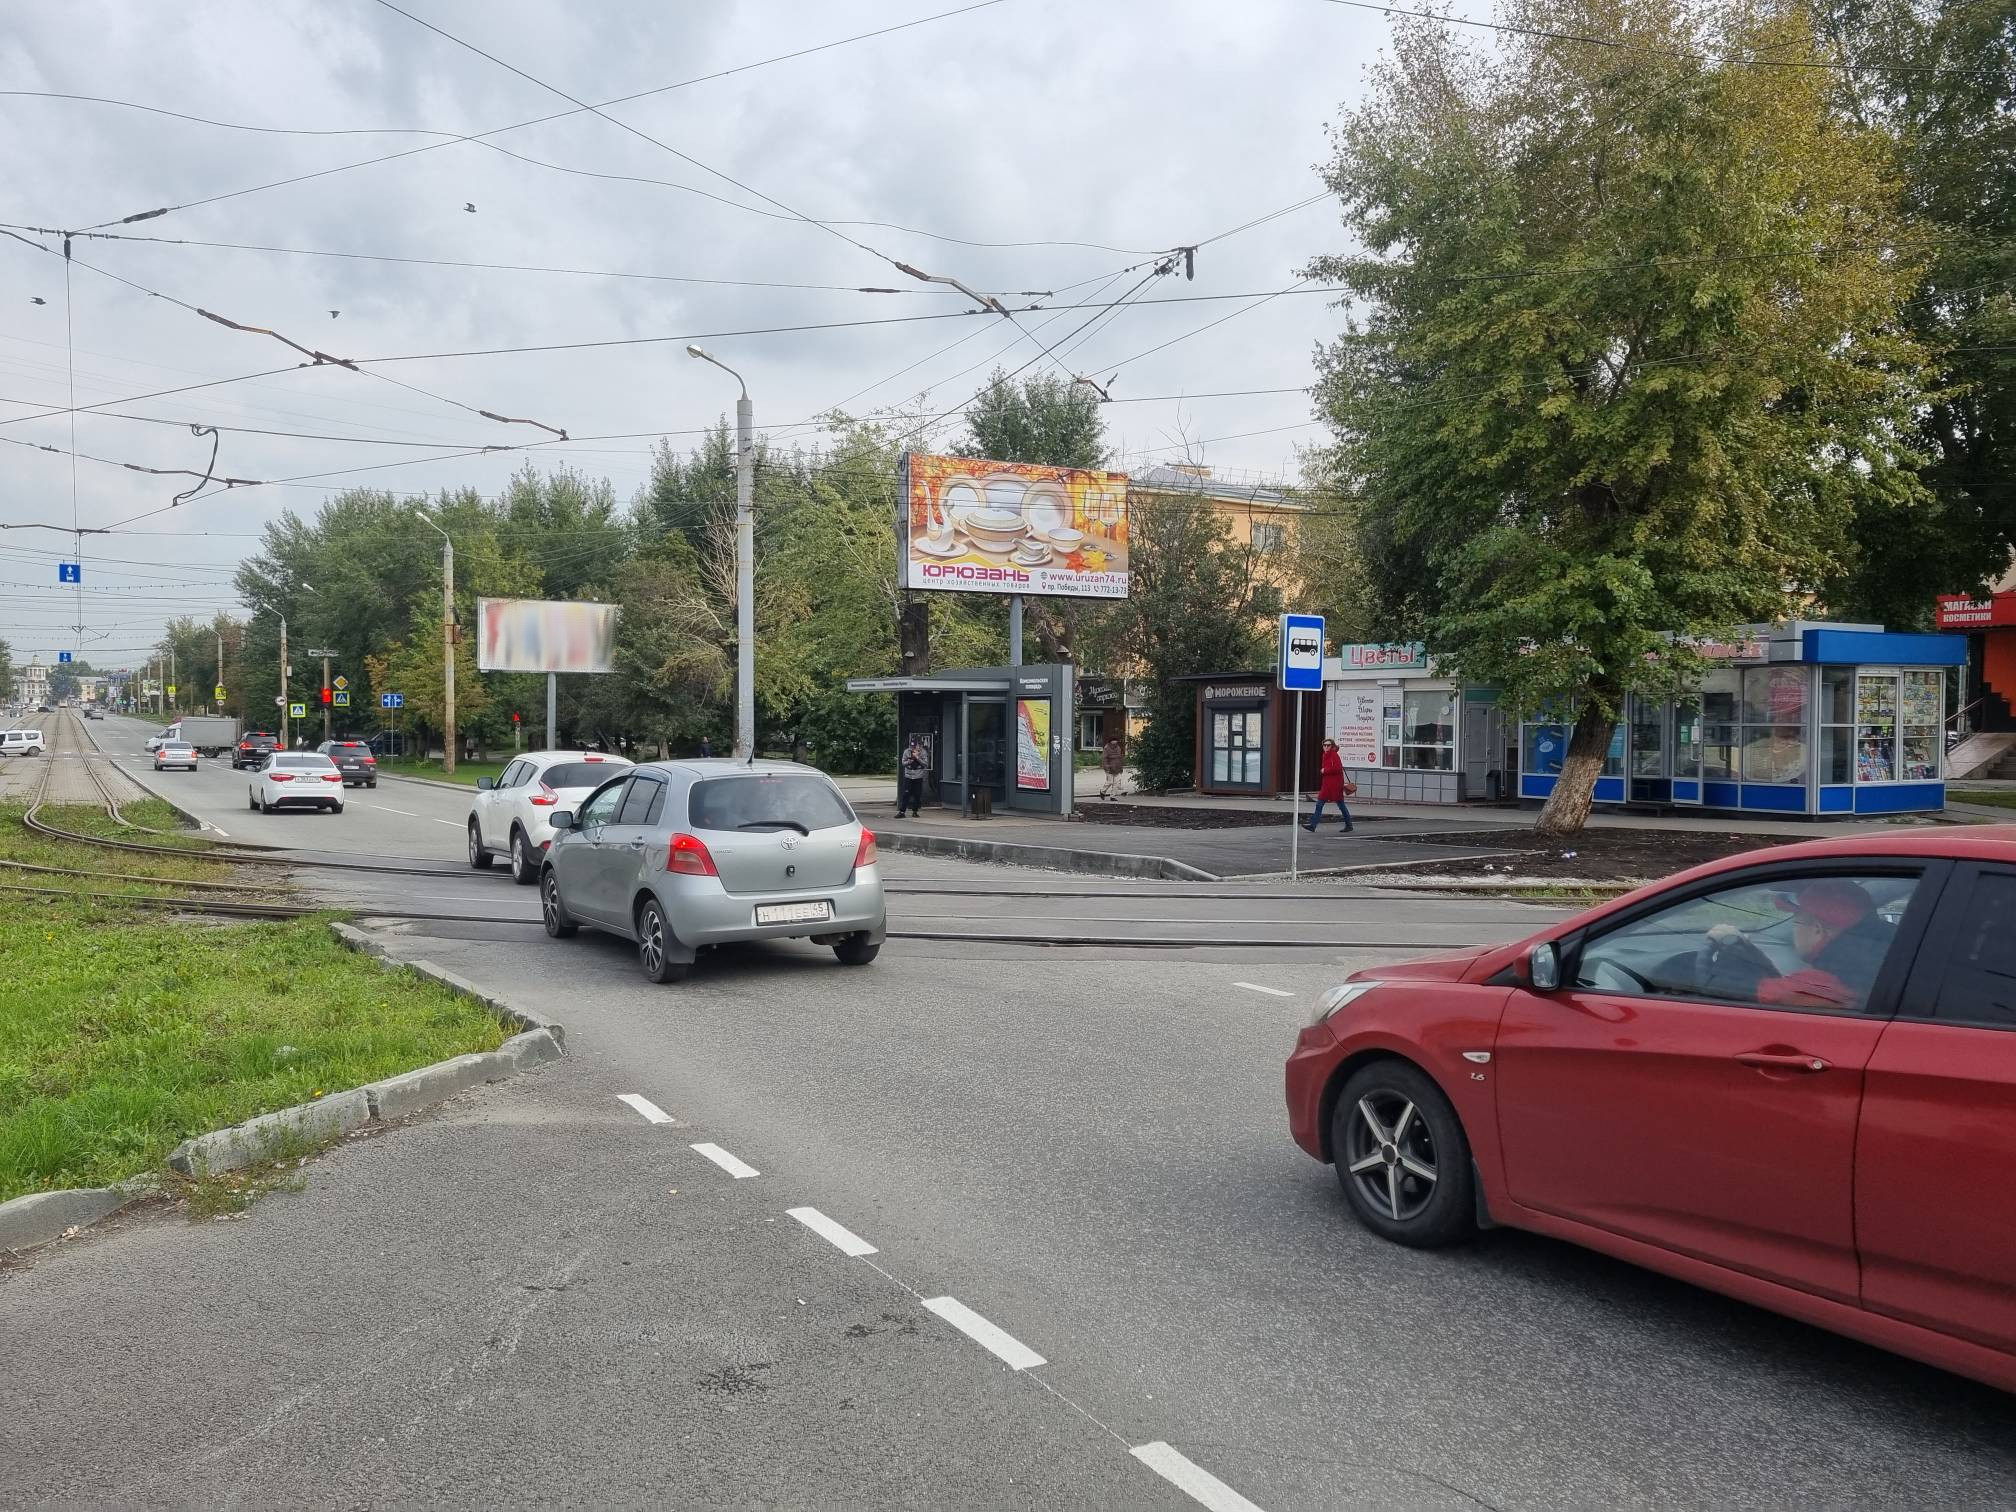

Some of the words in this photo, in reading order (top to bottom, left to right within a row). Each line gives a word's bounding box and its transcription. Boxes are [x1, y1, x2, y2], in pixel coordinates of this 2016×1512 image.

[922, 578, 944, 586] центр
[1049, 573, 1127, 585] www.uruzan74.ru
[1081, 584, 1091, 592] 113
[1943, 612, 1992, 623] КОСМЕТИКИ
[1351, 645, 1415, 668] Цветы
[1214, 686, 1267, 698] МОРОЖЕНОЕ
